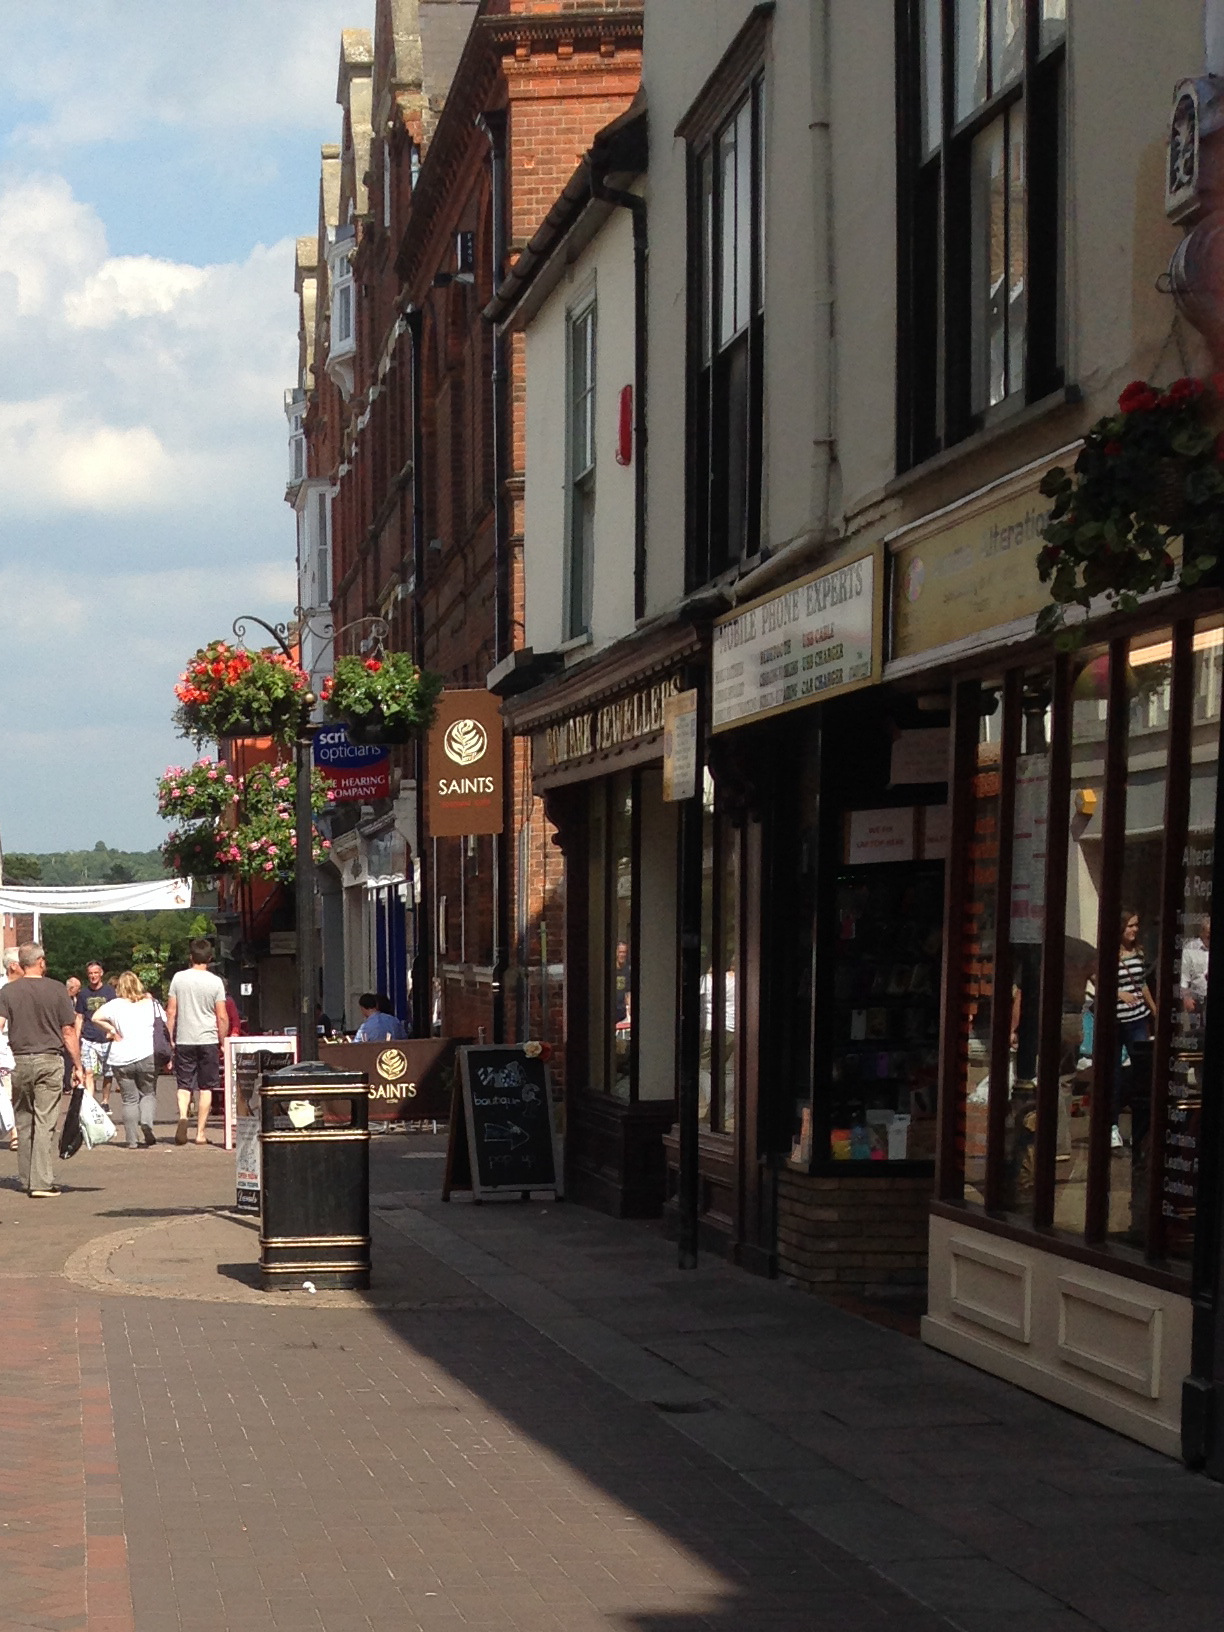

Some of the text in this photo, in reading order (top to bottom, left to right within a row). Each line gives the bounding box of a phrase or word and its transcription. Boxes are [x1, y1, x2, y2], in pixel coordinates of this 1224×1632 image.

[761, 592, 800, 636] PHONE
[804, 563, 864, 617] EXPERTS
[319, 727, 350, 745] scri
[320, 743, 382, 763] opticians
[341, 775, 386, 788] HEARING
[438, 777, 495, 796] SAINTS
[332, 785, 378, 799] OMPANY
[367, 1083, 418, 1099] SAINTS
